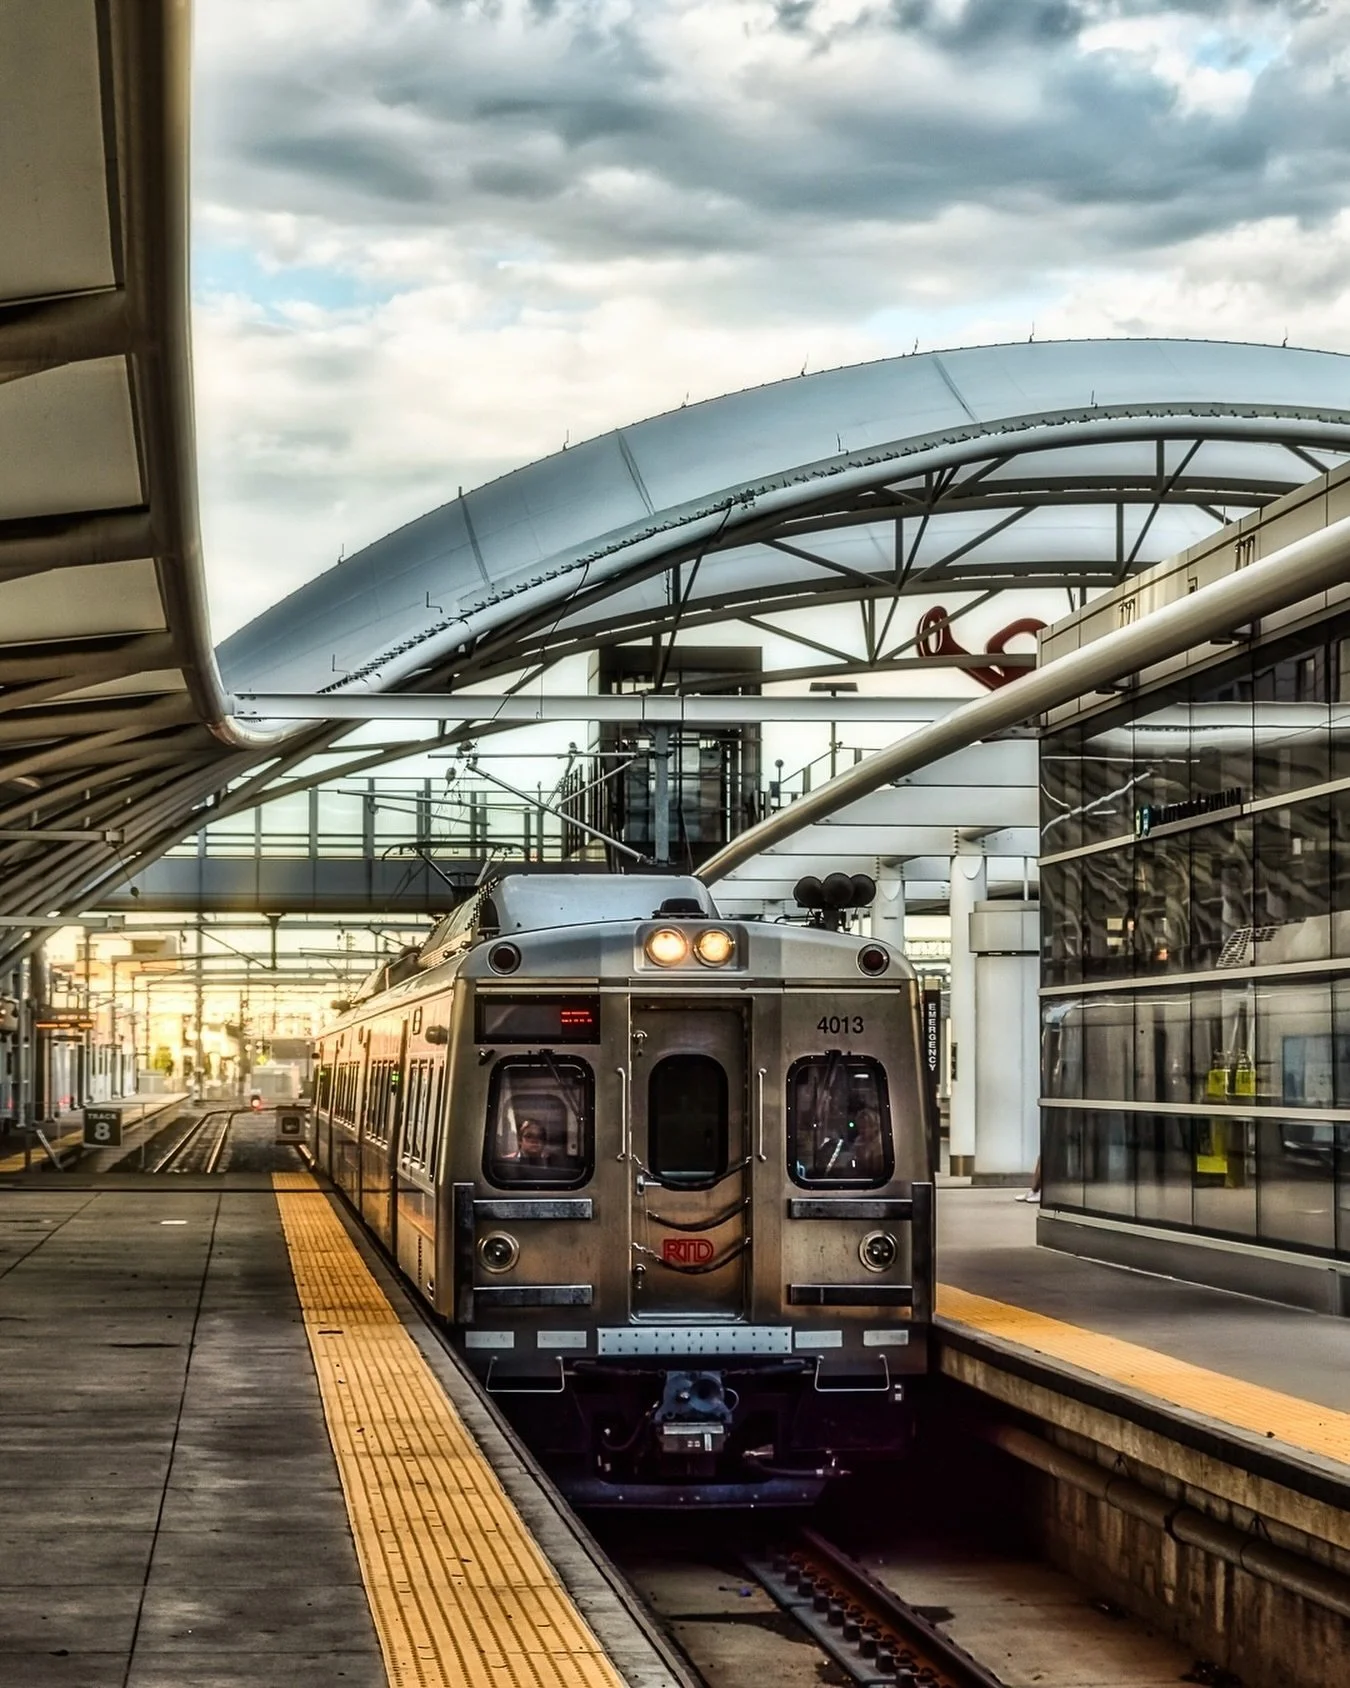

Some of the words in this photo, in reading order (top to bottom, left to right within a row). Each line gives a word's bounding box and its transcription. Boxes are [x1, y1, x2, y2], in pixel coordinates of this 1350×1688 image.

[817, 1016, 864, 1034] 4013
[928, 1003, 937, 1071] EMERGENCY
[94, 1121, 111, 1141] 8
[663, 1239, 714, 1265] RTD
